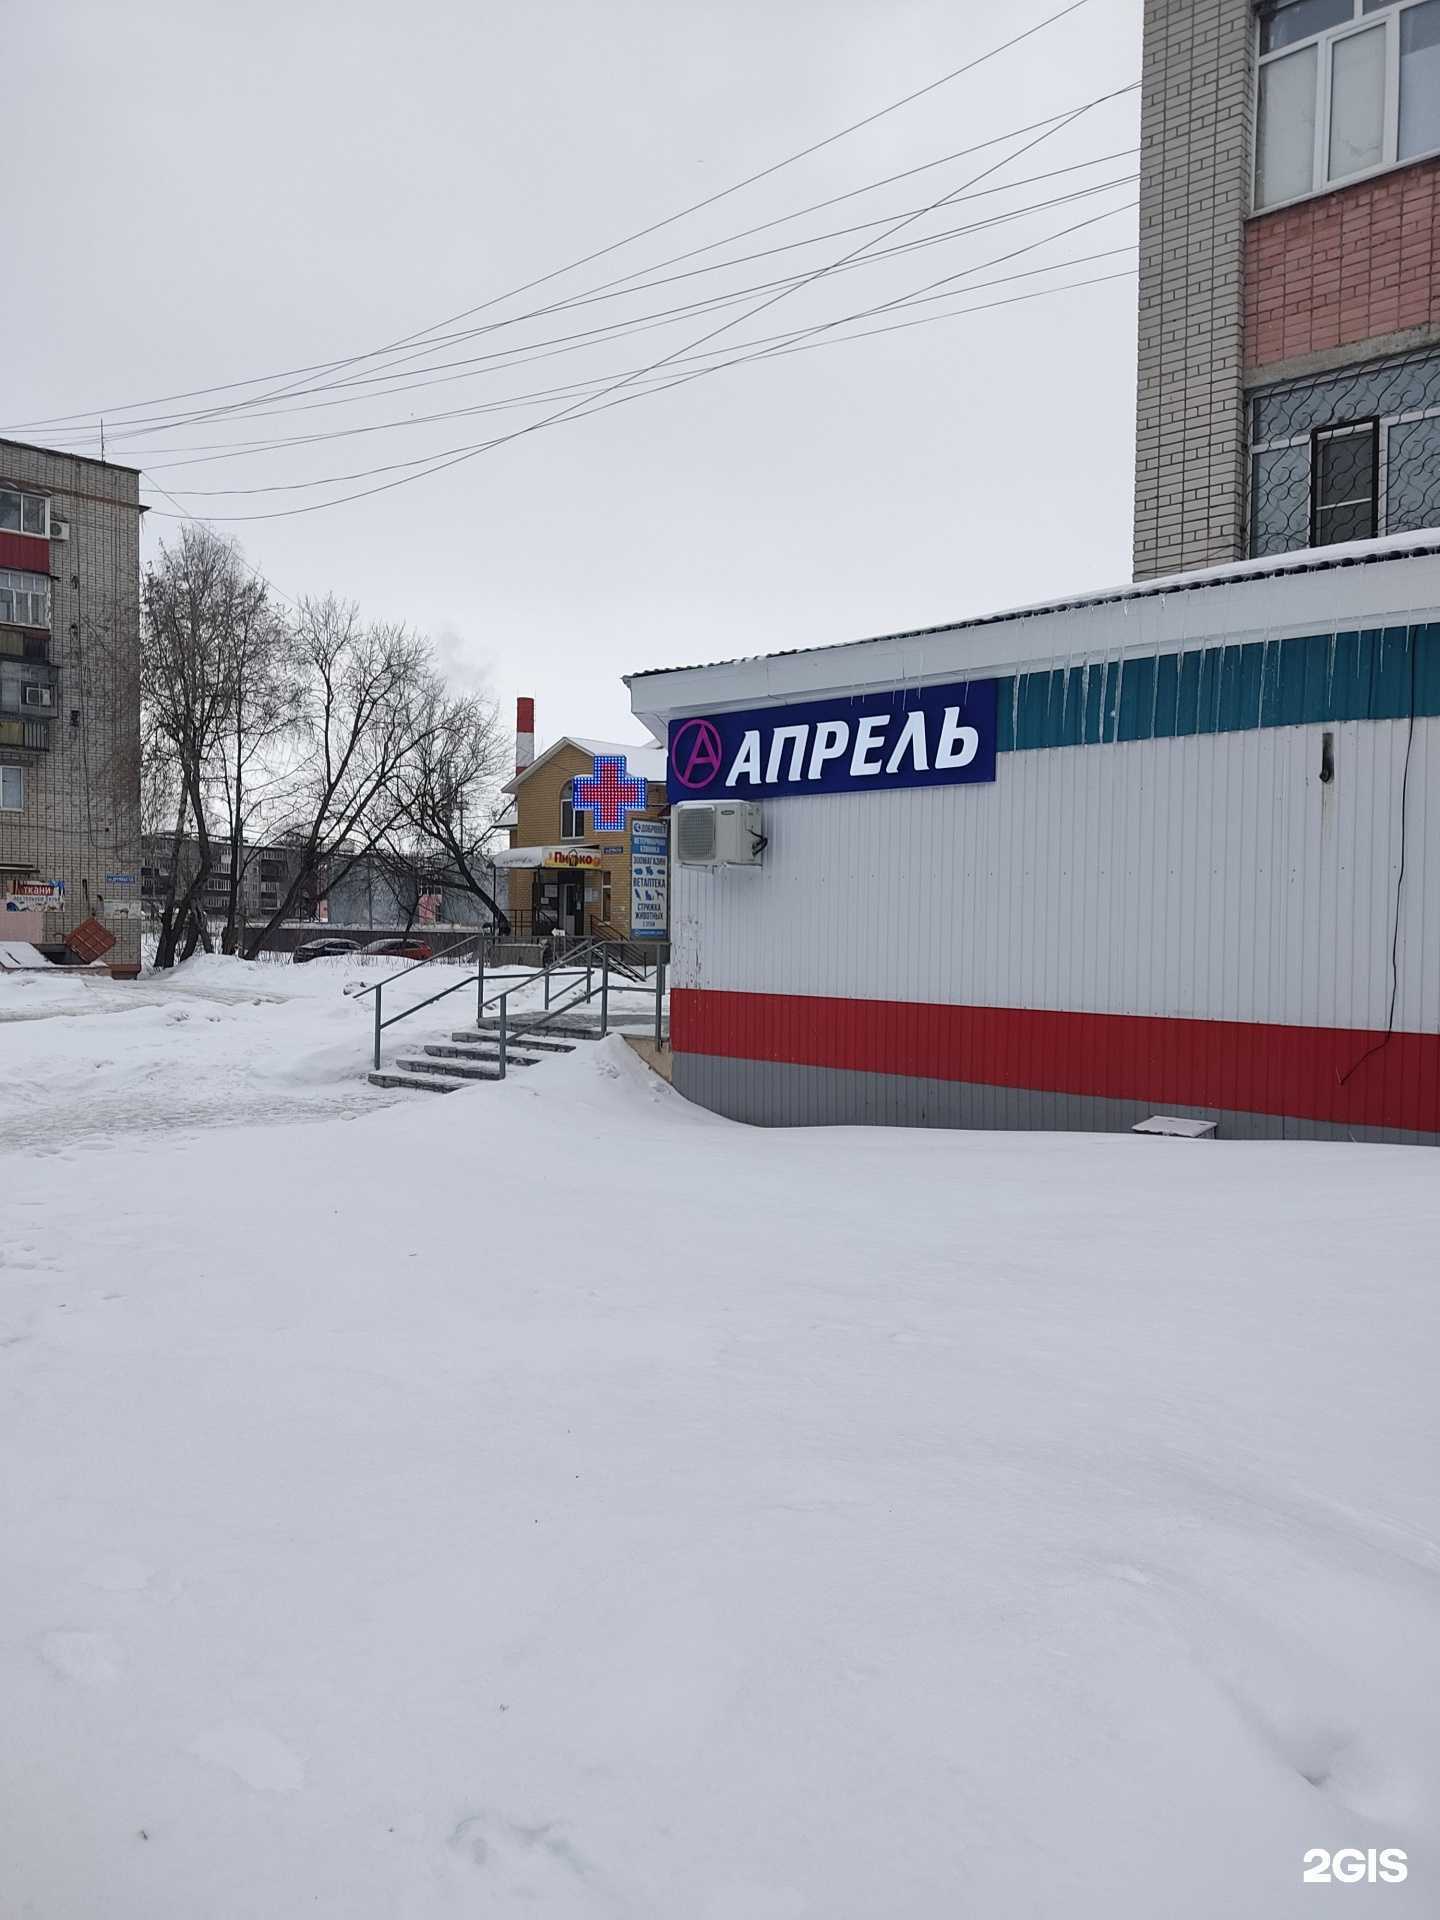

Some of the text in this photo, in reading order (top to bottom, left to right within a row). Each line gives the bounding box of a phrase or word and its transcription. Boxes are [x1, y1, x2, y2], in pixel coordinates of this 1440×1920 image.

[725, 706, 979, 787] АПРЕЛЬ
[633, 878, 665, 888] ВЕТАПТЕКА
[638, 903, 661, 912] СТРИЖКА
